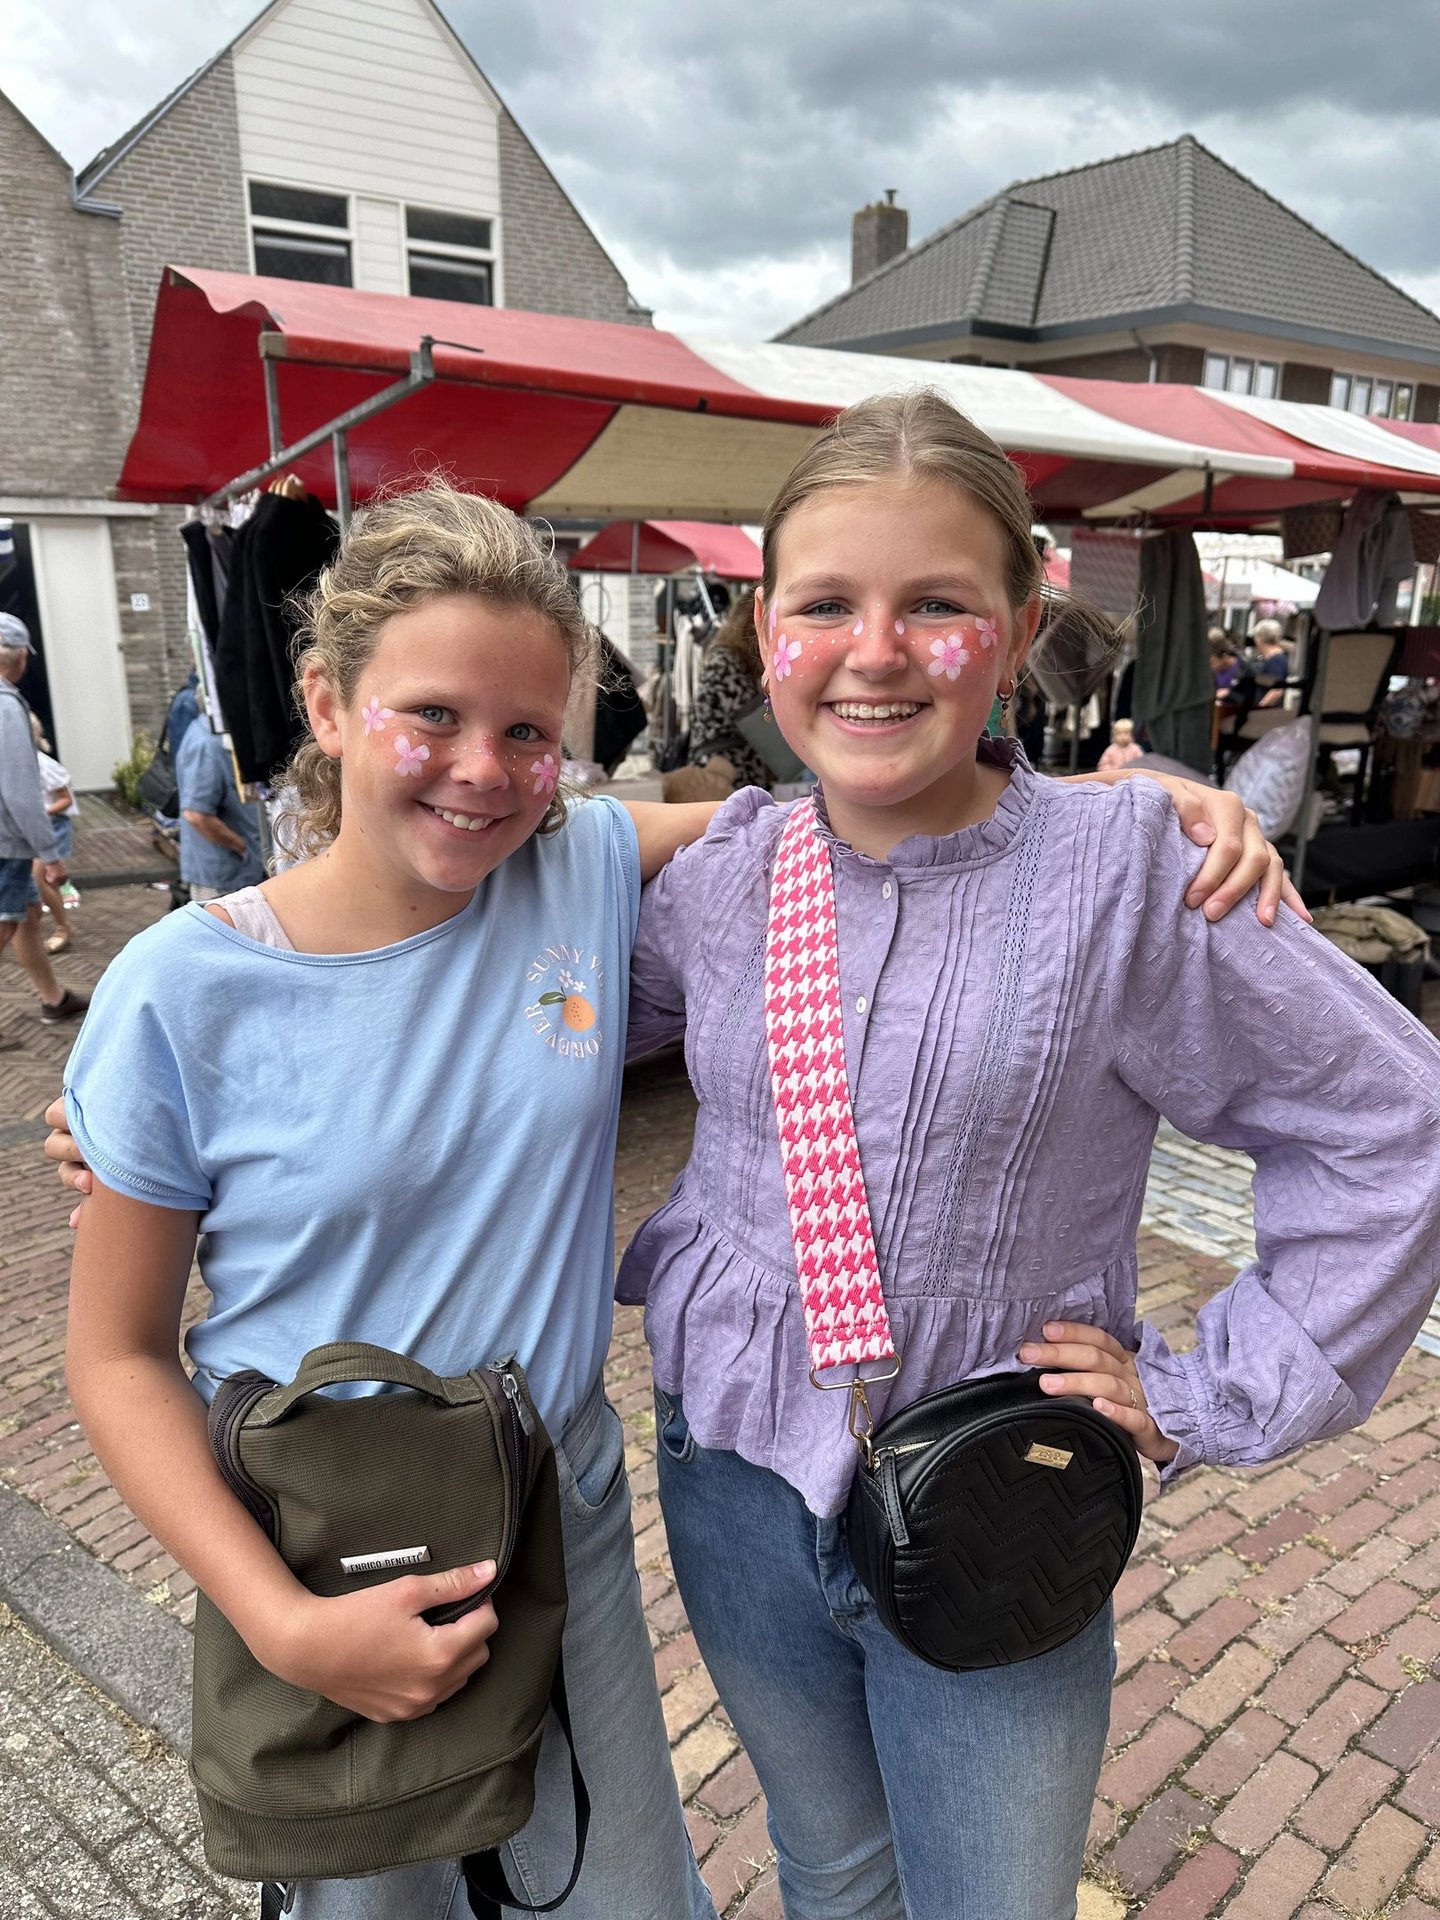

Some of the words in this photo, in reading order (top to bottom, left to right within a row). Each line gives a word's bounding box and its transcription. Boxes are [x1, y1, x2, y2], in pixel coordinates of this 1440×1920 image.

[527, 944, 584, 983] SUNNY
[350, 1560, 382, 1572] ENRICO
[385, 1554, 420, 1567] BENETTI
